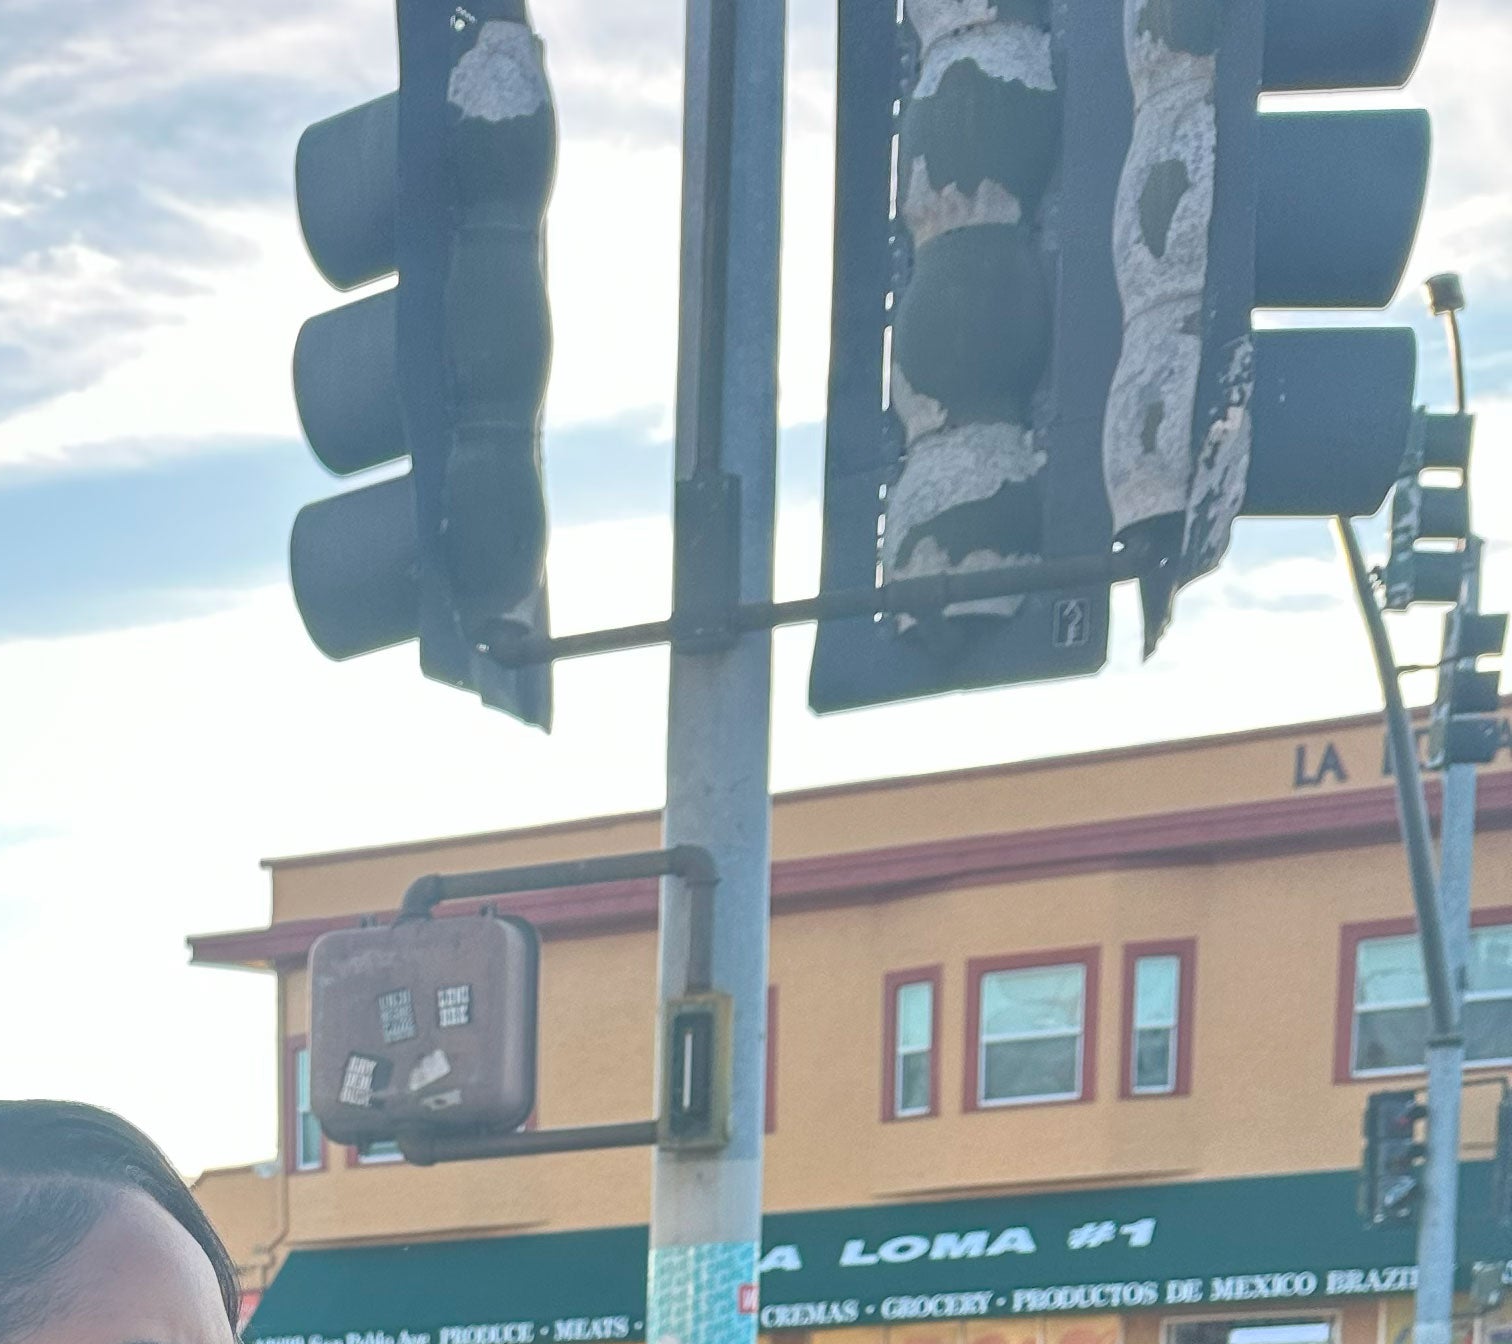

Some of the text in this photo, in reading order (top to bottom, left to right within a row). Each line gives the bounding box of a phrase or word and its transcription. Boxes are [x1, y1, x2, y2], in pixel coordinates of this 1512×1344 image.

[1294, 741, 1348, 789] LA
[838, 1226, 1037, 1267] LOMA
[1066, 1217, 1157, 1250] #1
[553, 1315, 630, 1342] MEATS
[760, 1299, 859, 1328] CREMAS
[880, 1290, 994, 1320] GROCERY
[1011, 1280, 1159, 1313] PRODUCTOS
[1166, 1278, 1203, 1303] DE
[1209, 1270, 1318, 1301] MEXICO
[1325, 1265, 1419, 1295] BRAZI
